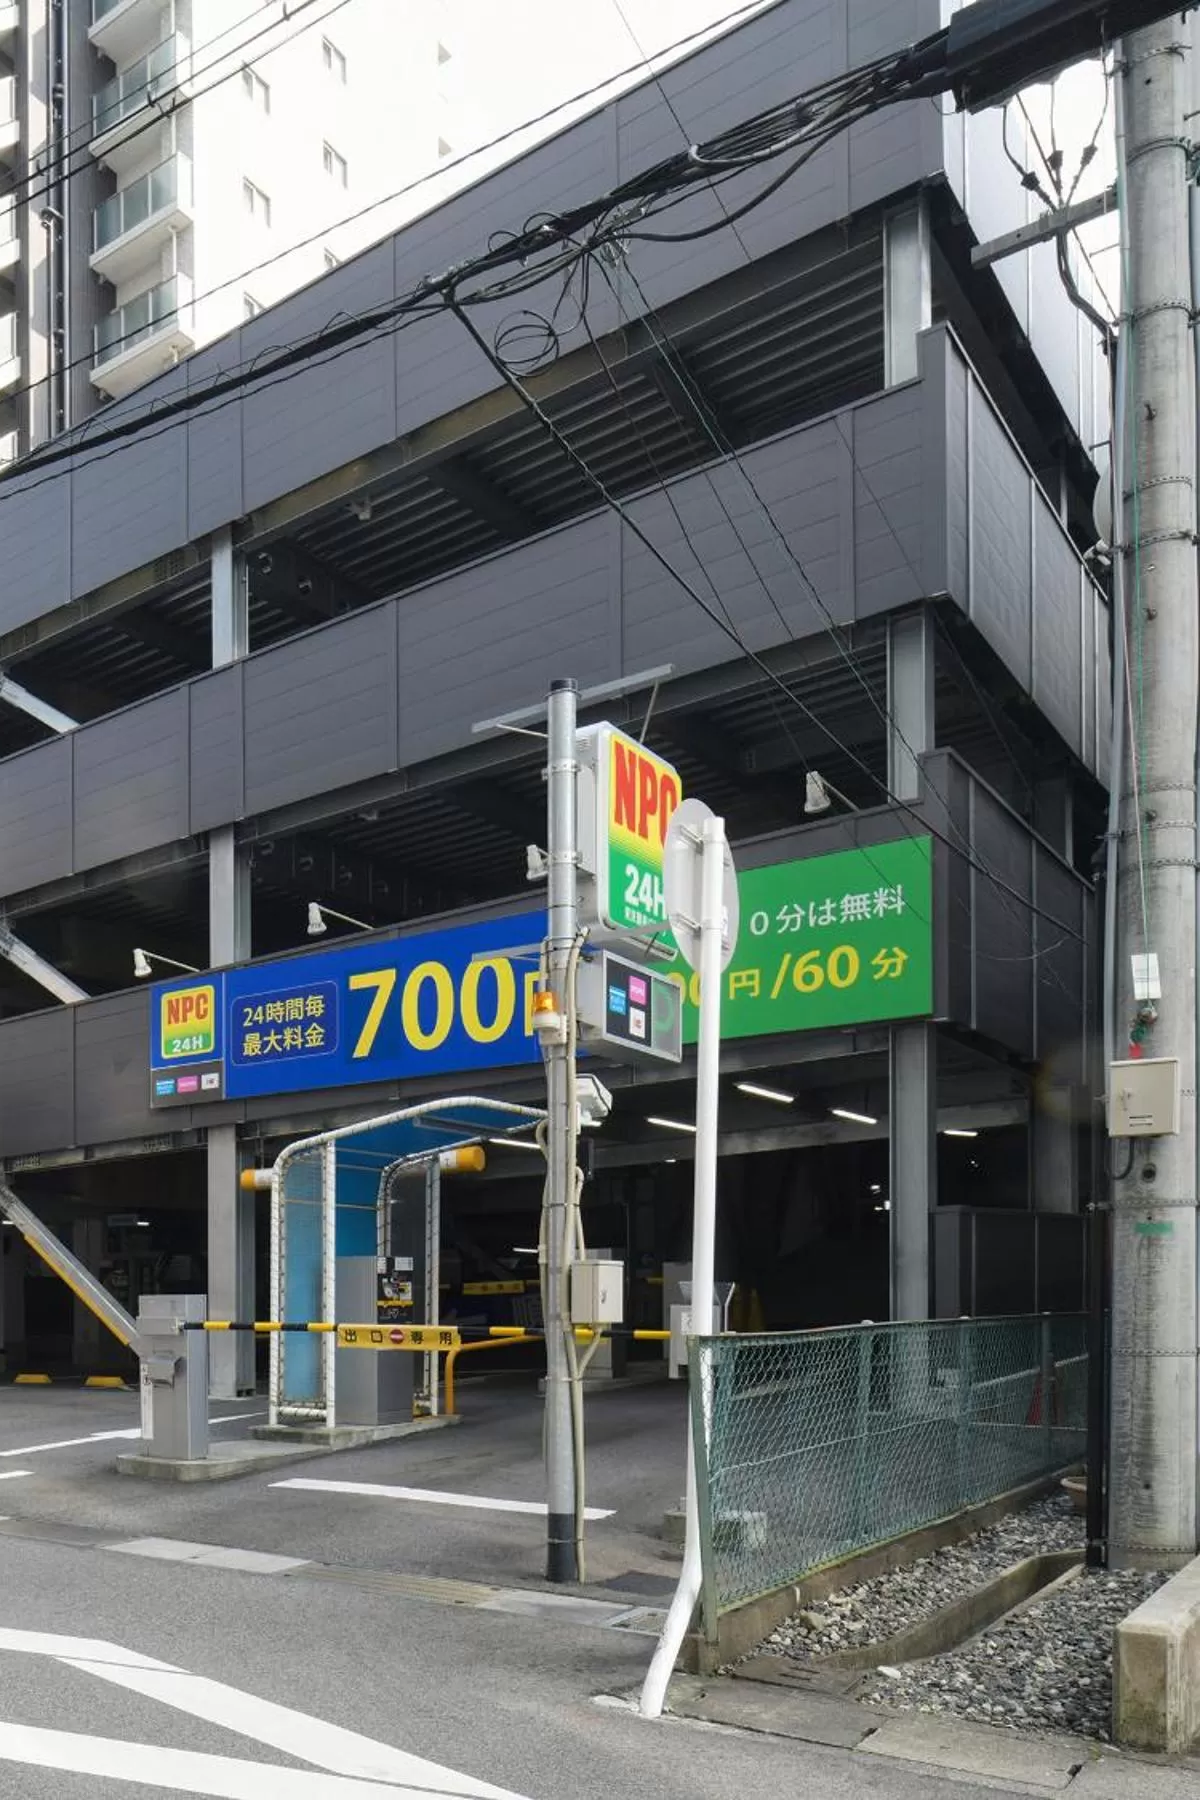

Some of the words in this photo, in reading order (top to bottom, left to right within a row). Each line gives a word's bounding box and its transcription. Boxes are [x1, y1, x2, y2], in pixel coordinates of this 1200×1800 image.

[750, 884, 905, 935] 0分は無料
[167, 993, 209, 1025] NPC
[243, 995, 325, 1027] 24時間毎
[172, 1035, 204, 1053] 24H
[243, 1023, 325, 1056] 最大料金
